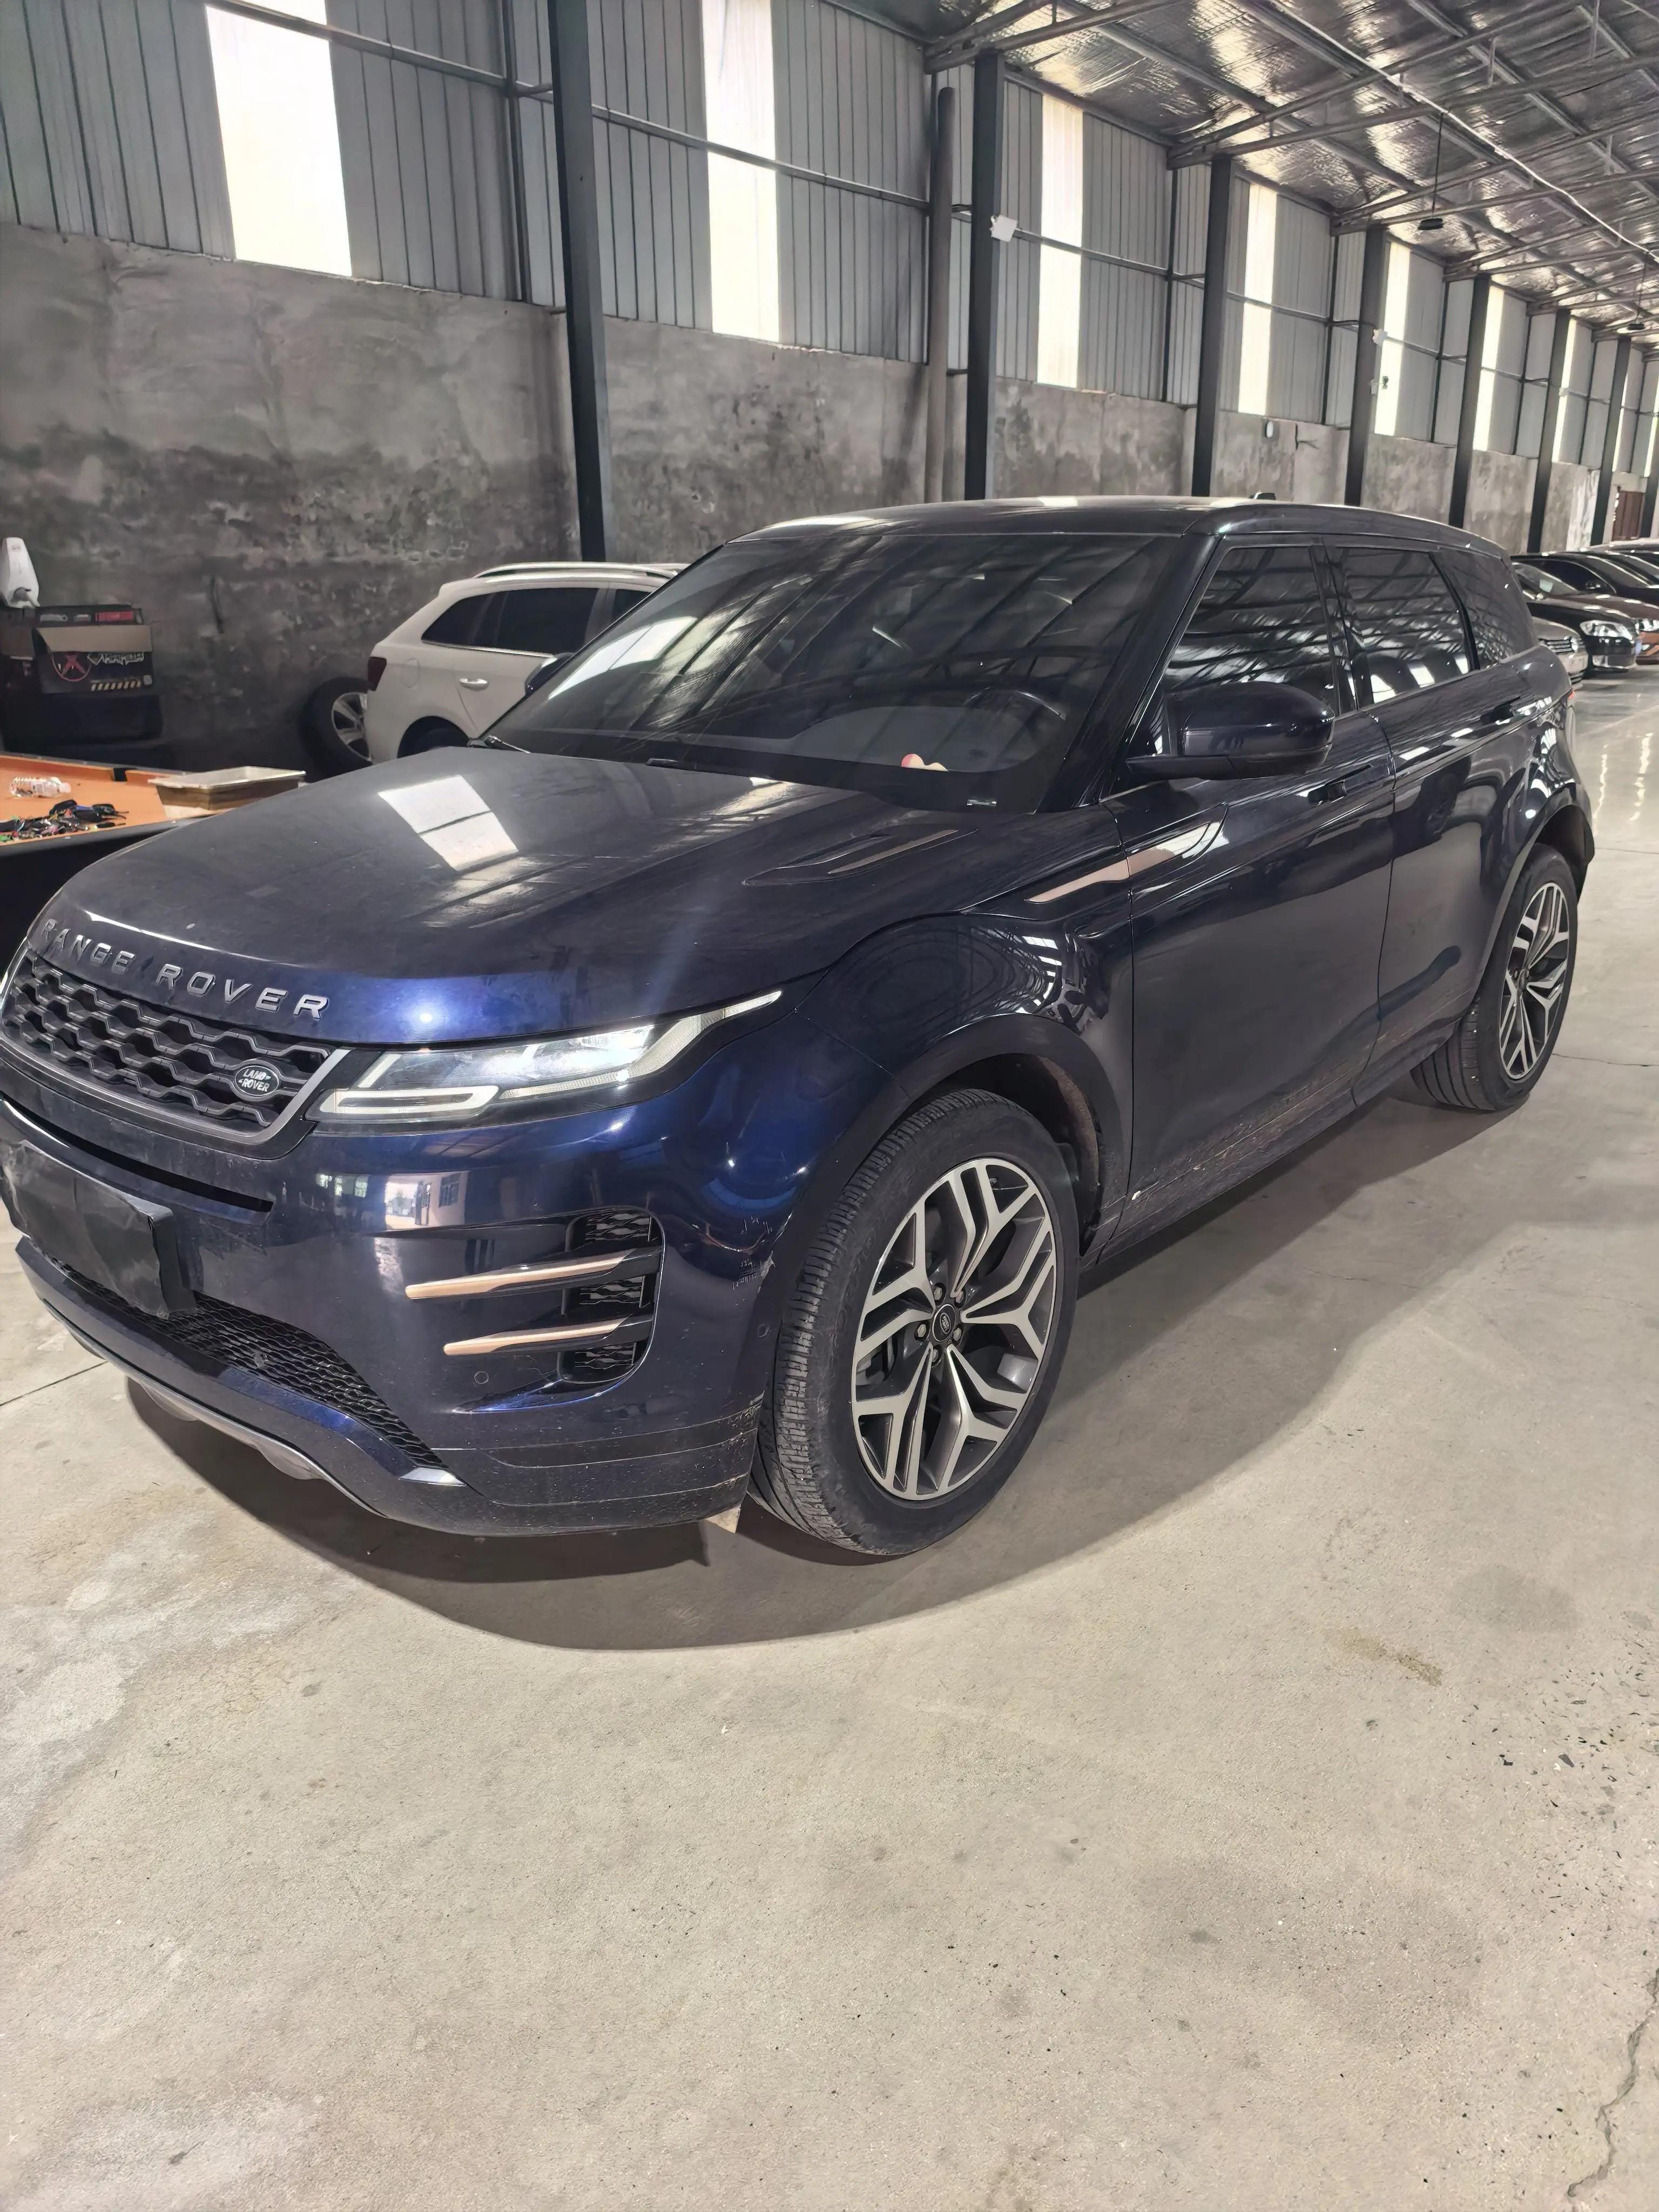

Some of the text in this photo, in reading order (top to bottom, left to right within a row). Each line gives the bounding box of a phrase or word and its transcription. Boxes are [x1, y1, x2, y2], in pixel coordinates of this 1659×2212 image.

[41, 919, 329, 1019] RANGE ROVER
[242, 1069, 267, 1081] LAND
[241, 1078, 270, 1092] ROVER
